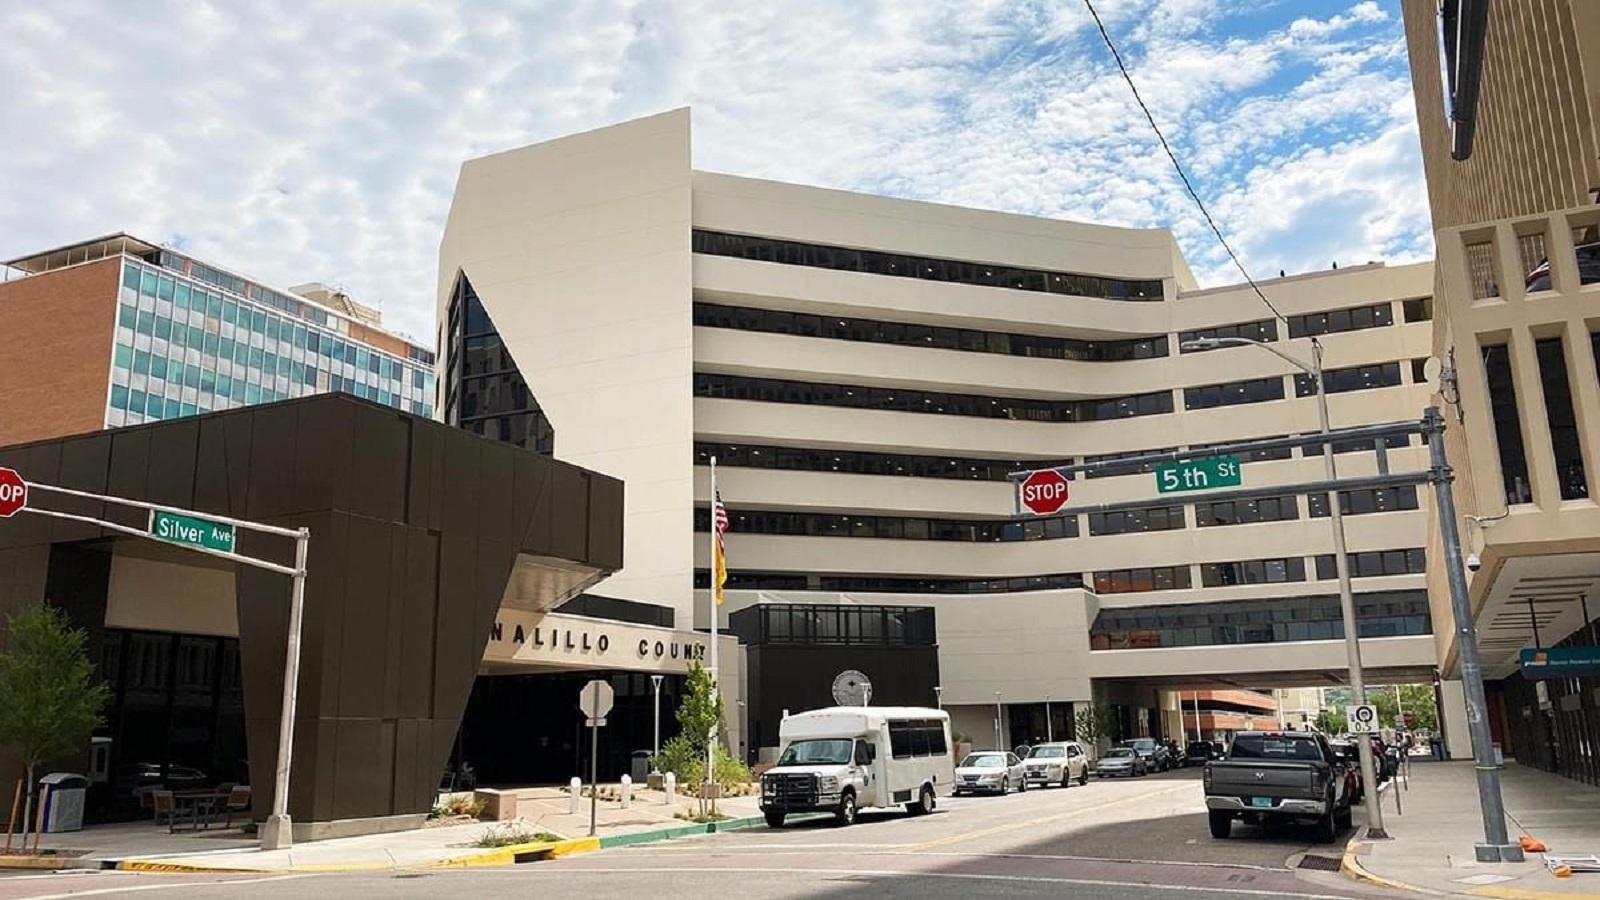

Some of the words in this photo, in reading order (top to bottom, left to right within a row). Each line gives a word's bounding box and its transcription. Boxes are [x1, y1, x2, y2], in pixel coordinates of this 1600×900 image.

[1163, 468, 1208, 490] 5th
[1217, 462, 1236, 477] St
[1025, 483, 1066, 502] STOP
[159, 518, 204, 543] Silver
[212, 526, 231, 543] Ave
